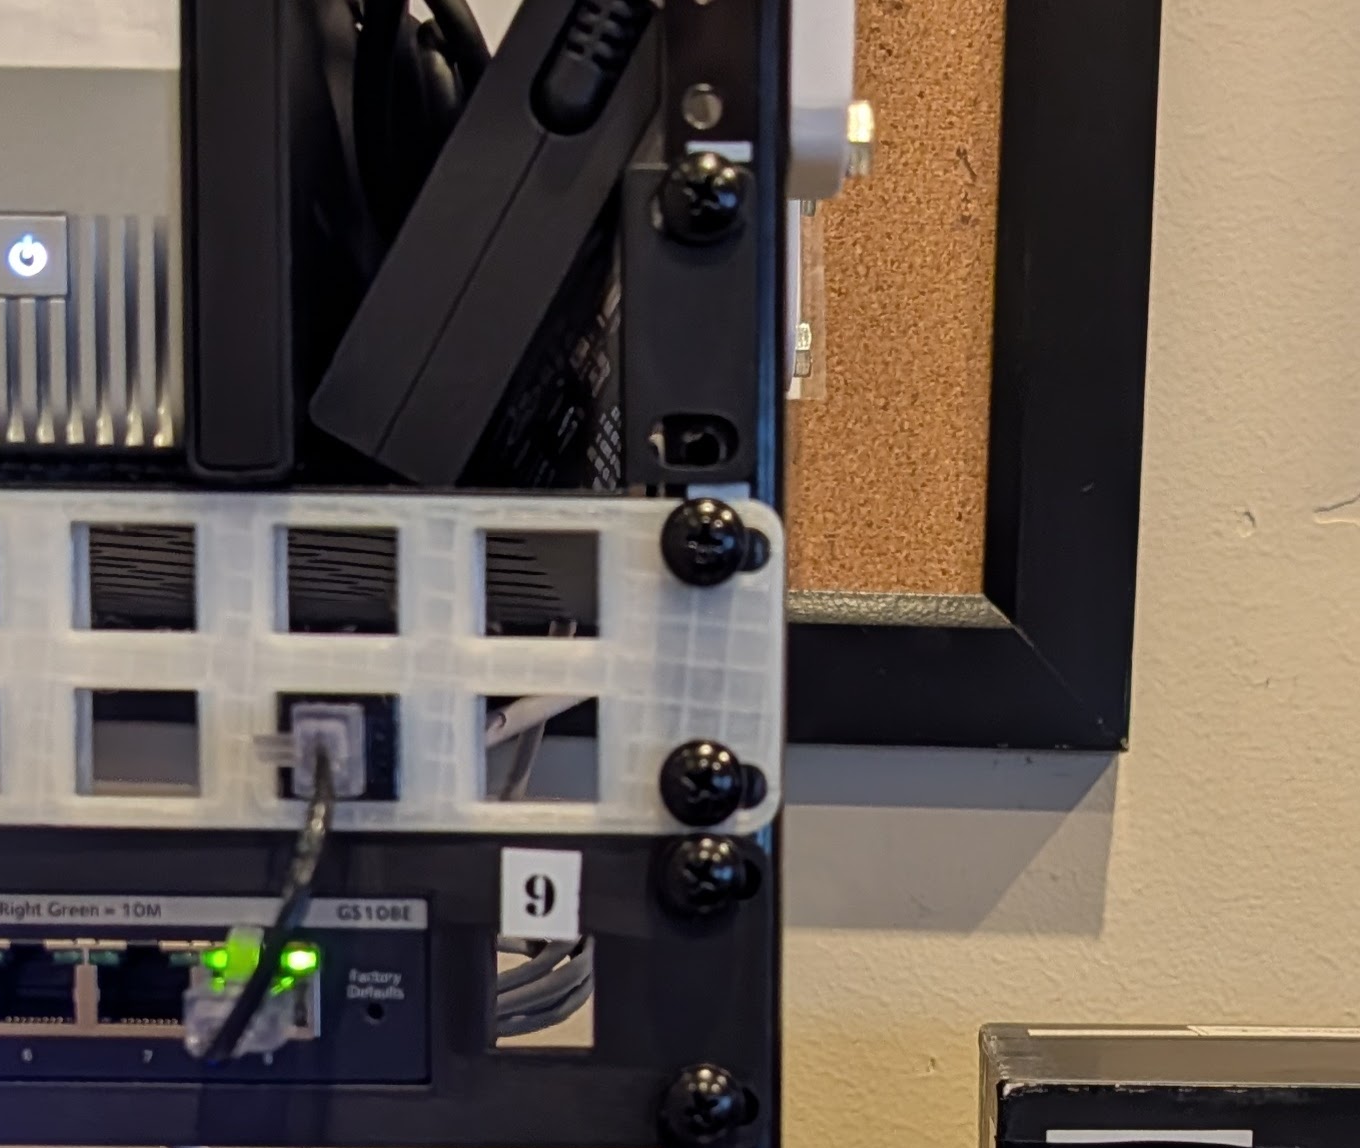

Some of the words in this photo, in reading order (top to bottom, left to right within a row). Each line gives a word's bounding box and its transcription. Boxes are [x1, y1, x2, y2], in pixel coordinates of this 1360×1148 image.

[524, 874, 556, 917] 9
[48, 902, 99, 918] Green
[122, 903, 162, 919] 10M
[143, 1049, 153, 1063] 7
